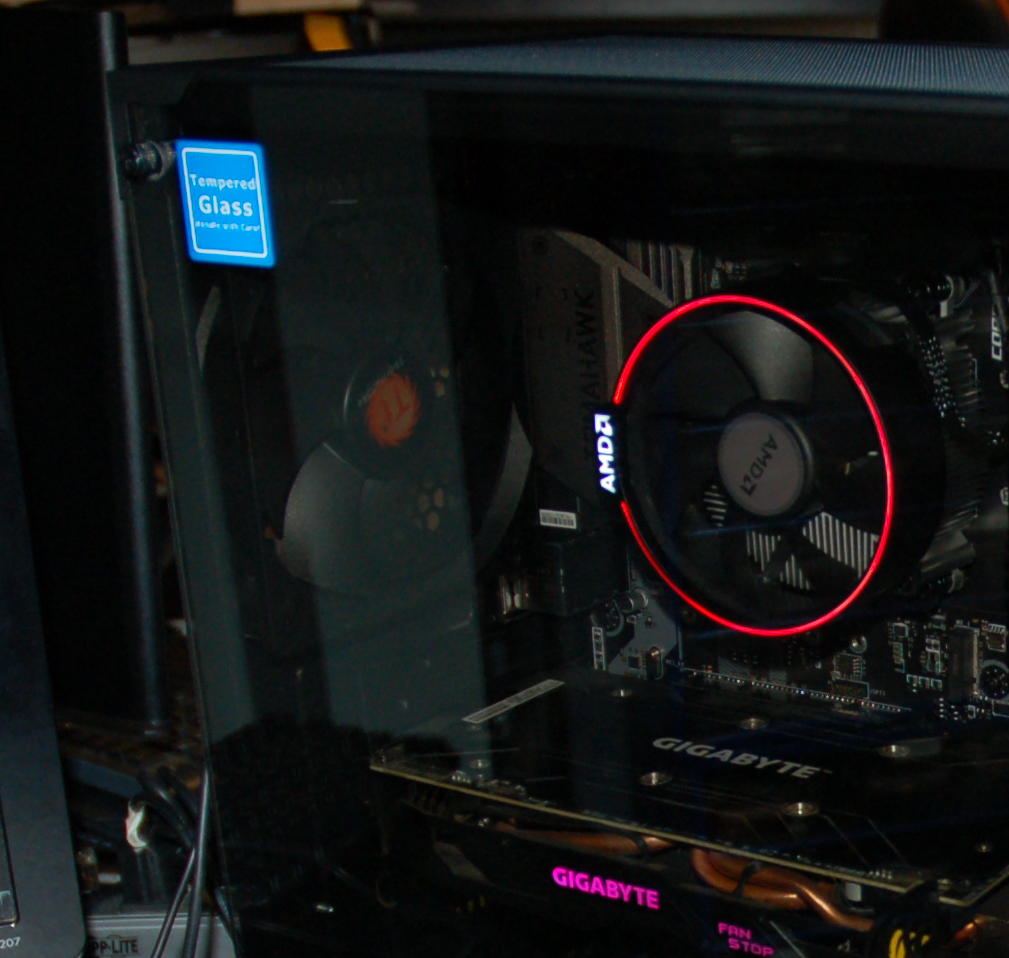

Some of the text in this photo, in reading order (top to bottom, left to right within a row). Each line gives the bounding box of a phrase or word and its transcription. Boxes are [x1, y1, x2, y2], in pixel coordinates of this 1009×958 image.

[189, 173, 257, 191] Tempered
[198, 195, 253, 217] Glass
[596, 431, 617, 494] AMD
[652, 737, 822, 779] GIGABYTE
[552, 866, 660, 910] GIGABYTE
[718, 922, 752, 940] FAN
[728, 937, 774, 957] STOP
